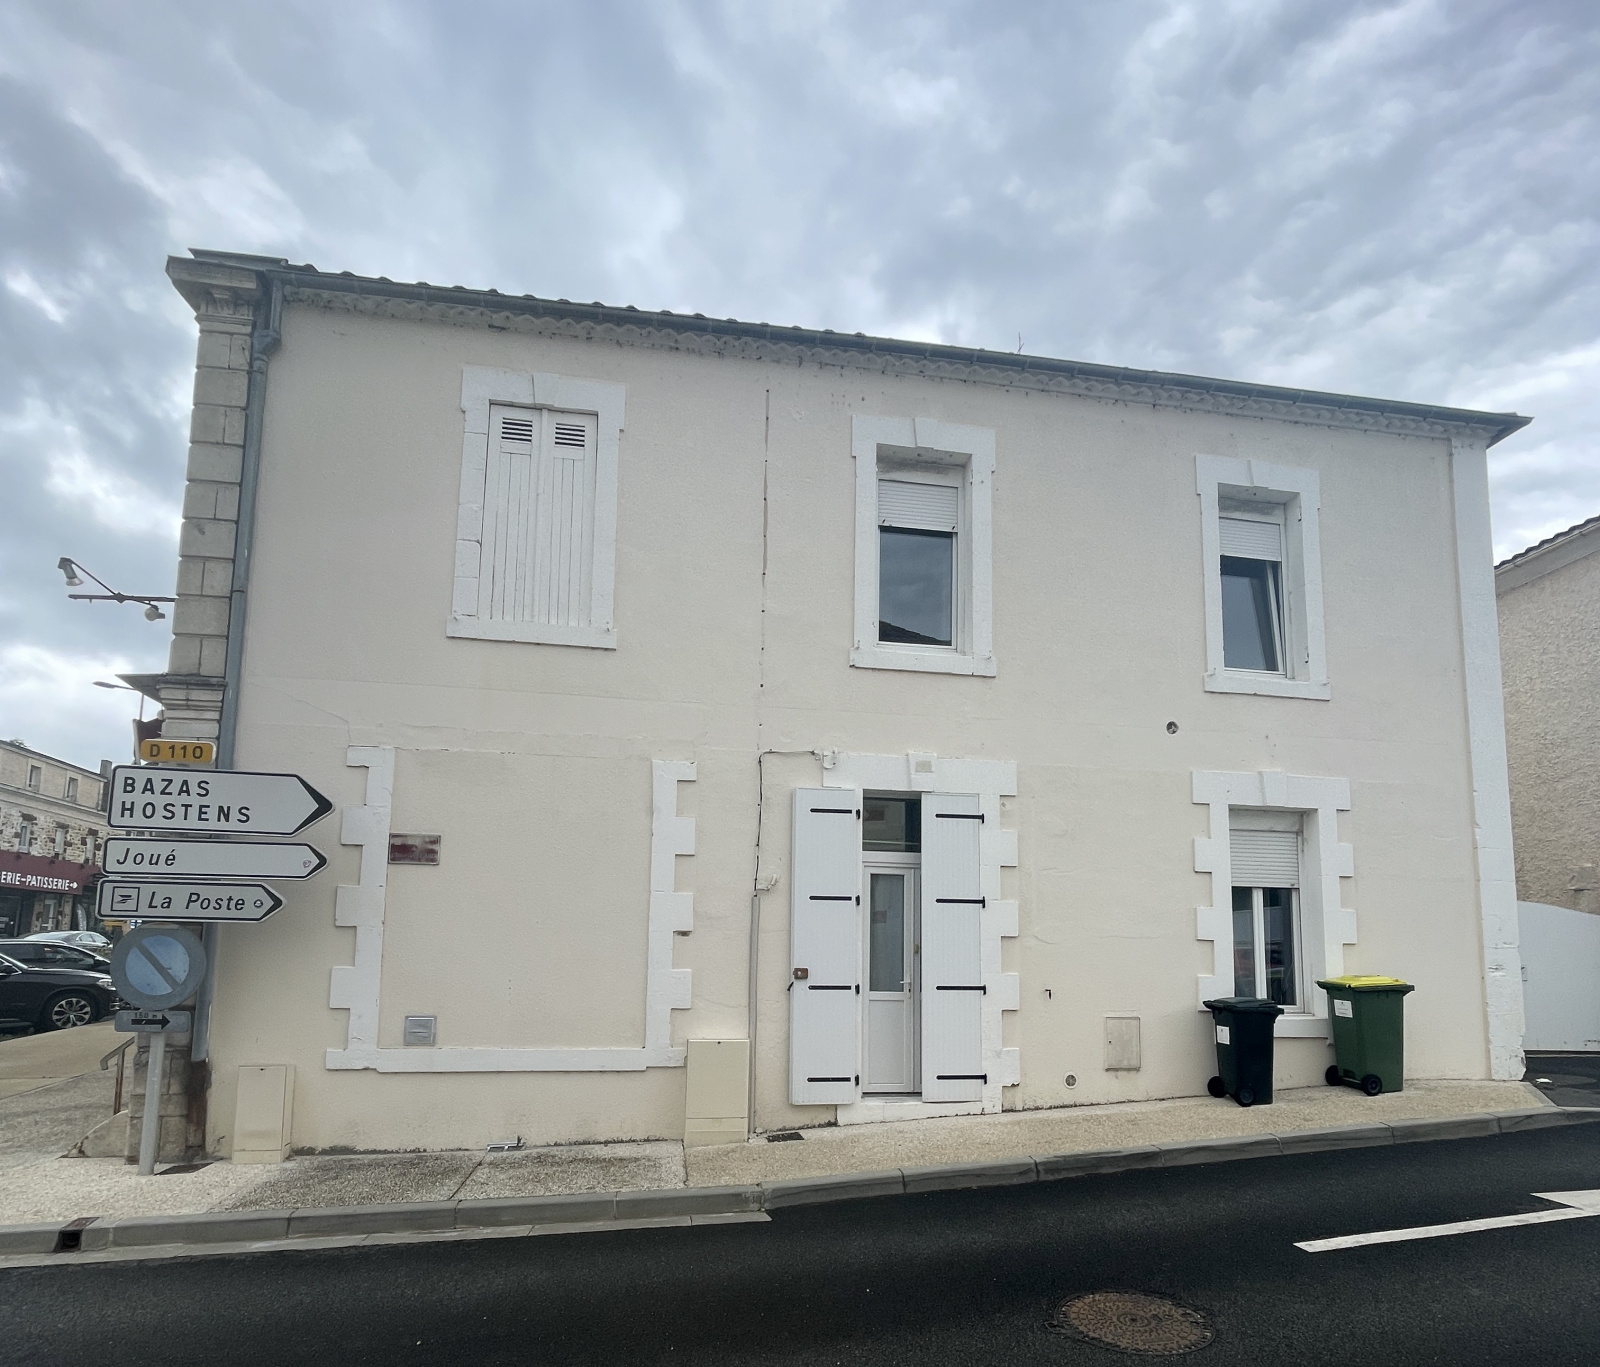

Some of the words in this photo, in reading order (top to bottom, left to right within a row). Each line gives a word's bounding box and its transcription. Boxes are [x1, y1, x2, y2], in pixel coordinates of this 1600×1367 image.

[149, 743, 161, 758] D
[168, 744, 204, 760] 110
[122, 776, 211, 797] BAZAS
[120, 800, 251, 824] HOSTENS
[116, 847, 177, 867] Joué
[0, 871, 70, 891] ERIE-PATISSERIE
[147, 891, 173, 910] La
[185, 891, 246, 911] Poste
